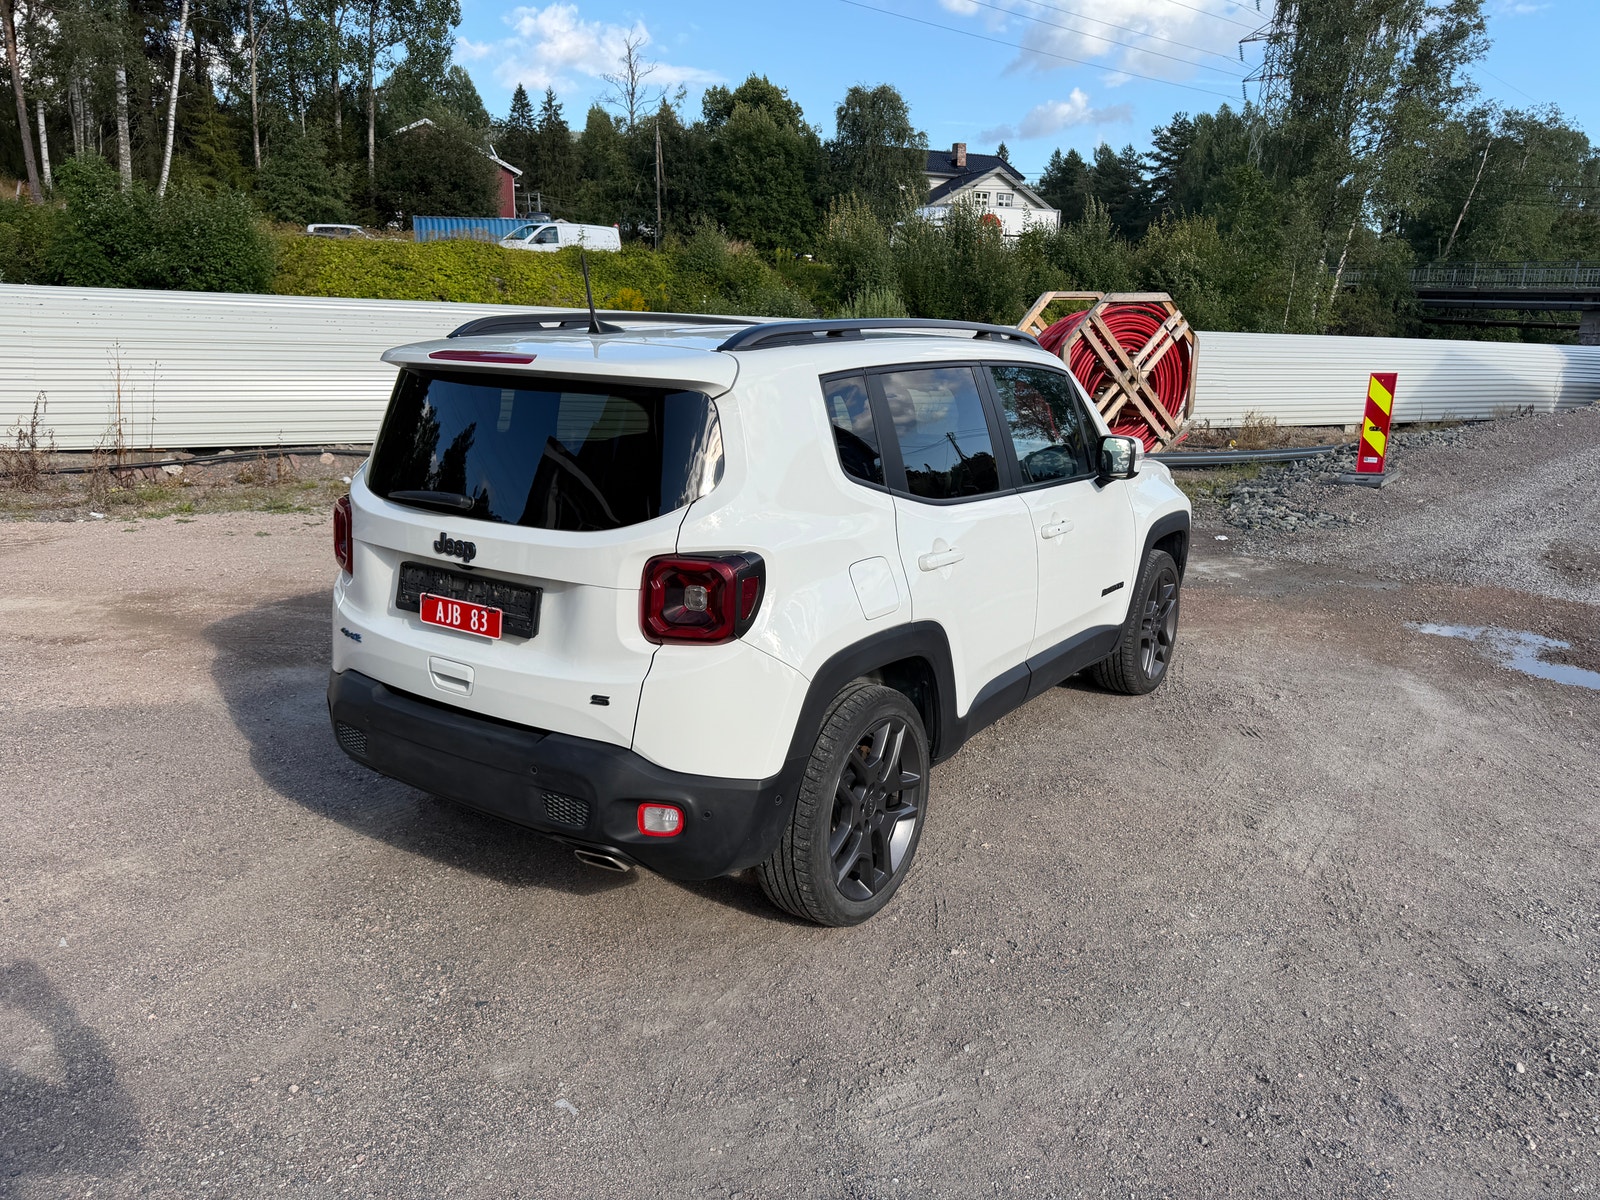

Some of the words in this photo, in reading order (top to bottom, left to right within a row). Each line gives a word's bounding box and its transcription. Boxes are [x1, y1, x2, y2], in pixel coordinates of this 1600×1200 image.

[433, 531, 477, 563] Jeep
[436, 601, 461, 625] AJB
[470, 609, 488, 632] 83
[589, 694, 610, 706] S
